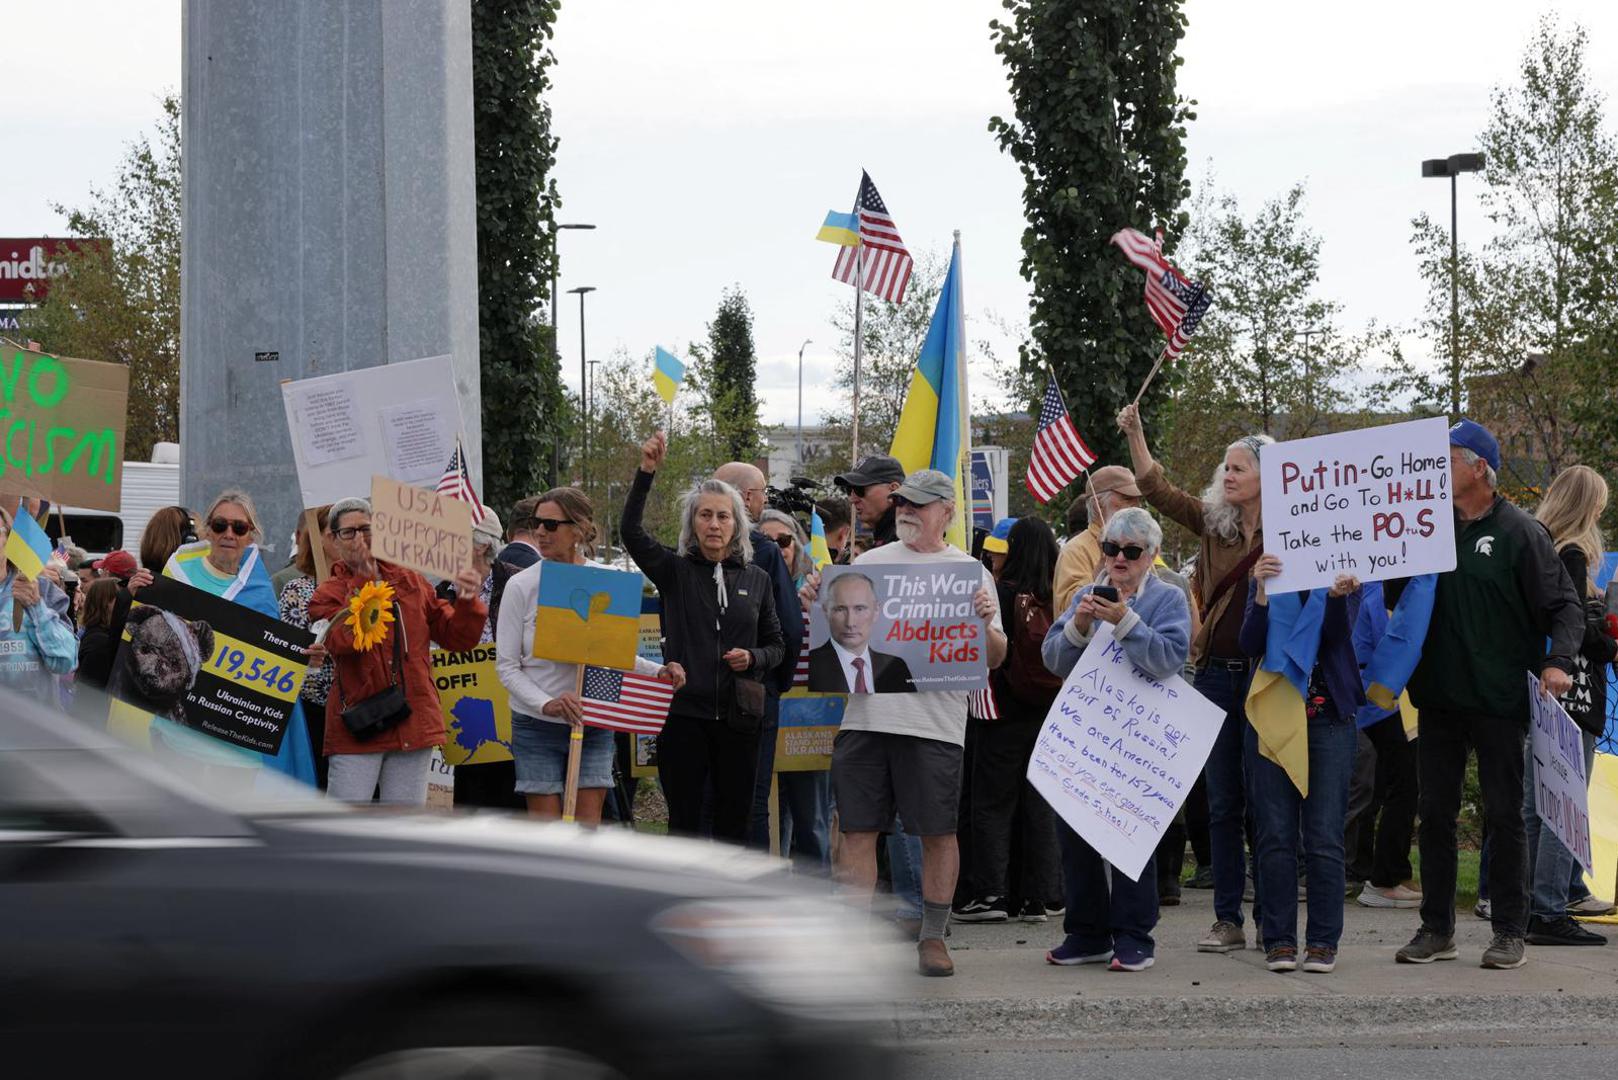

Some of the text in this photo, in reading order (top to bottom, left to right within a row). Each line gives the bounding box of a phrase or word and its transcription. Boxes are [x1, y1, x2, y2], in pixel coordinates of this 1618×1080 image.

[1401, 452, 1446, 475] Home
[398, 487, 443, 518] USA
[1290, 494, 1318, 517] and
[1324, 493, 1349, 510] Go
[1358, 488, 1381, 506] To
[375, 511, 469, 557] SUPPORTS
[1279, 530, 1321, 551] Take
[1331, 524, 1362, 544] the
[383, 537, 467, 575] UKRAINE
[1315, 541, 1407, 574] with you!
[883, 573, 979, 597] This War
[263, 631, 289, 649] There
[885, 618, 979, 642] Abducts
[431, 647, 497, 667] HANDS
[929, 640, 980, 664] Kids
[1101, 639, 1124, 664] Mr.
[215, 645, 296, 693] 19,546
[436, 673, 478, 690] OFF!
[186, 692, 280, 733] in Russian Captivity.
[216, 688, 284, 720] Ukrainian Kids
[1148, 706, 1162, 726] is
[1103, 704, 1121, 722] of
[1121, 717, 1177, 761] Russia!
